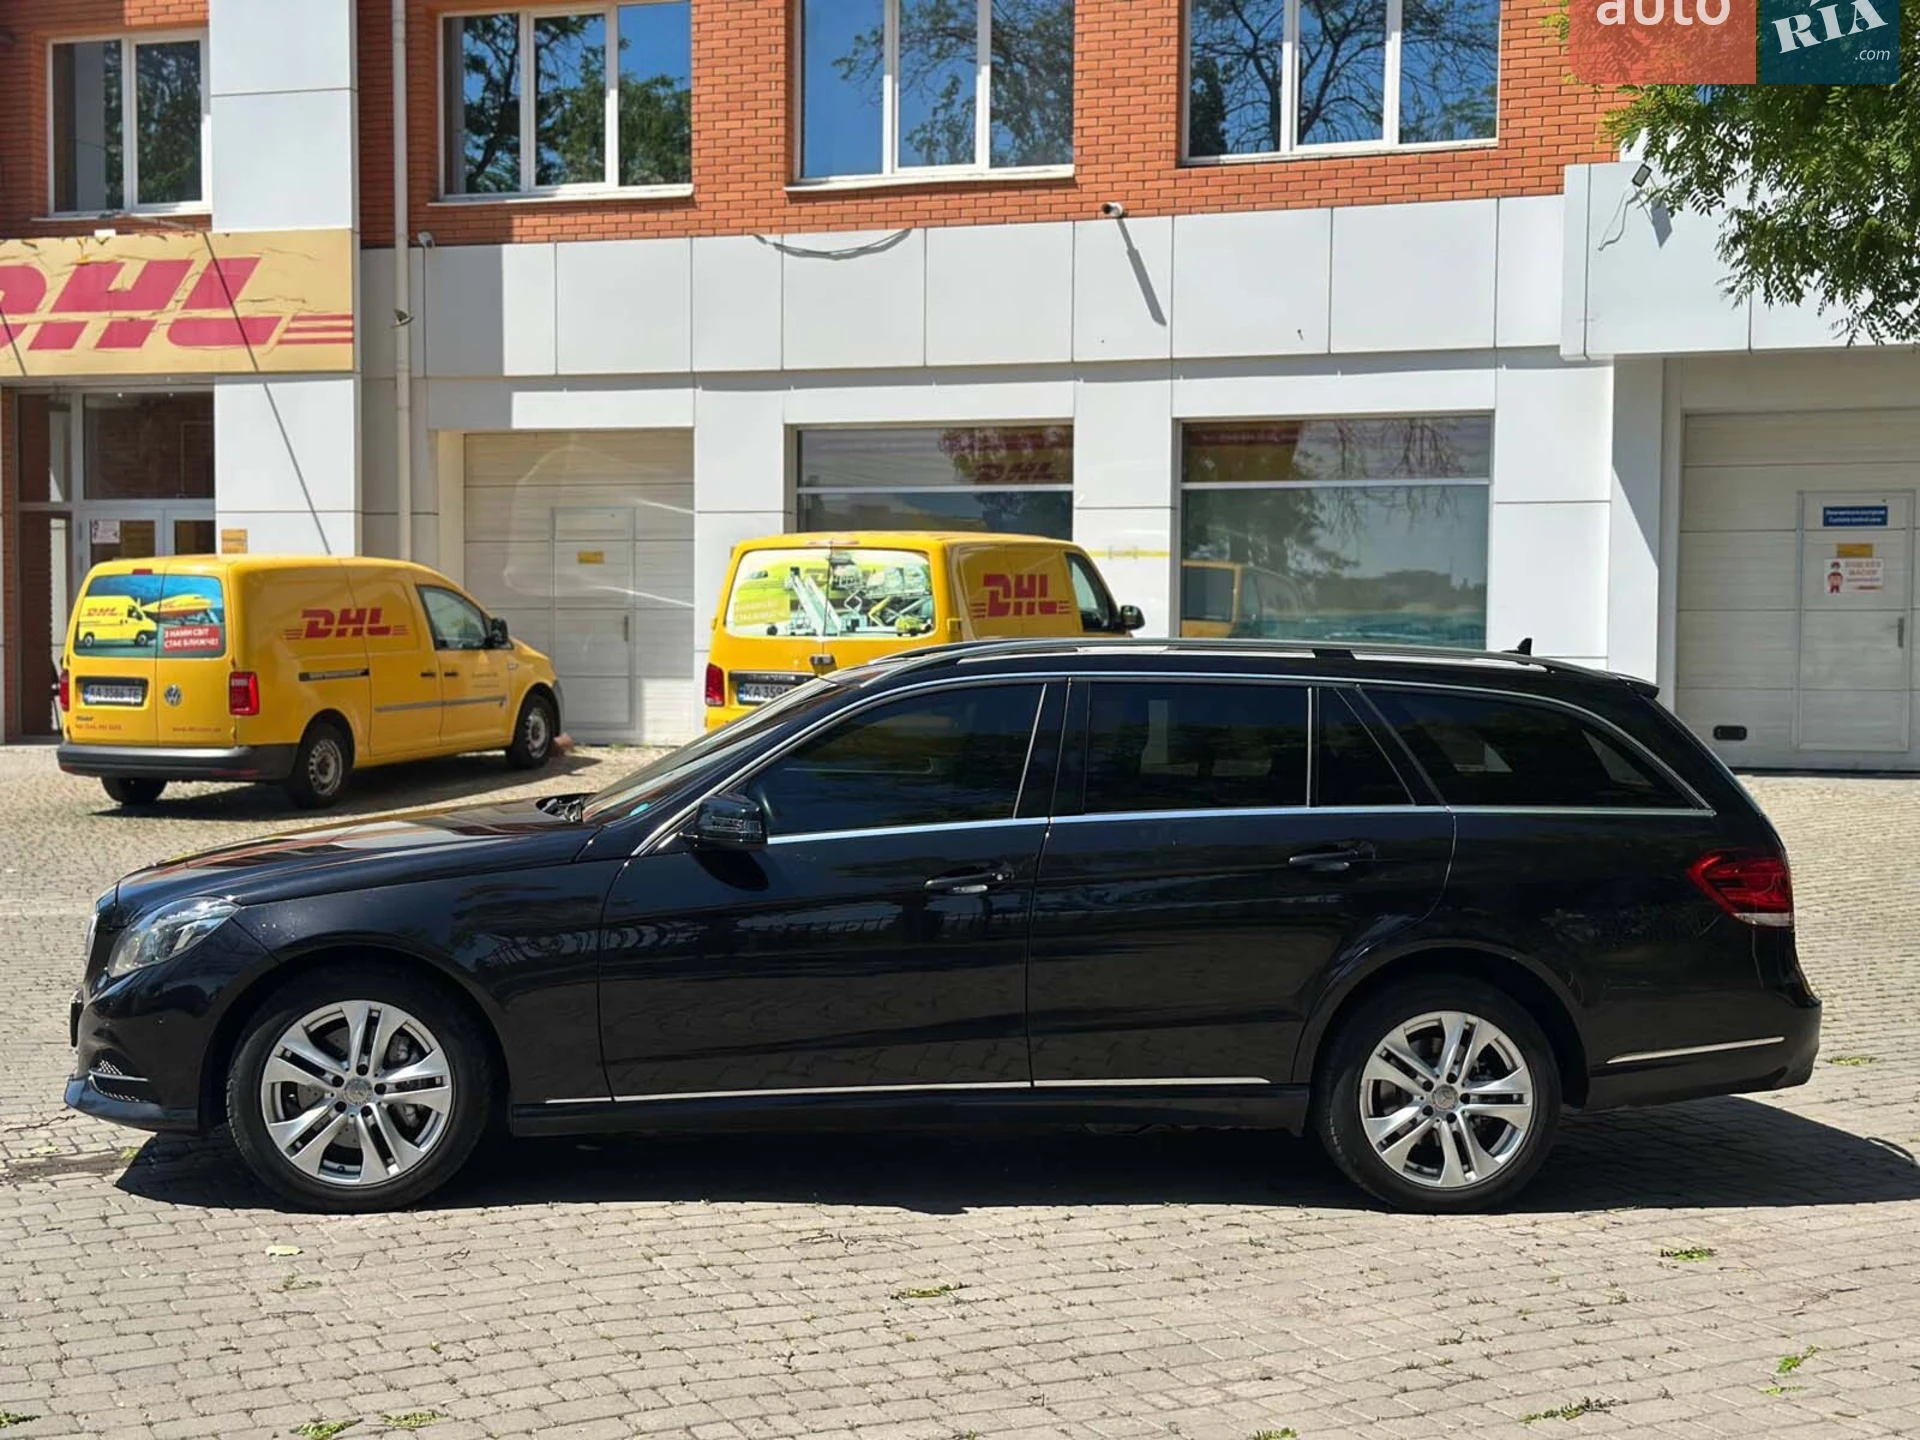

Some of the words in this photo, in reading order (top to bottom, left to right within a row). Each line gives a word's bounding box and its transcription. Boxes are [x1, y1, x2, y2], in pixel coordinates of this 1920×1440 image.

[0, 256, 283, 351] HL
[983, 573, 1058, 617] DHL
[301, 607, 391, 639] DHL
